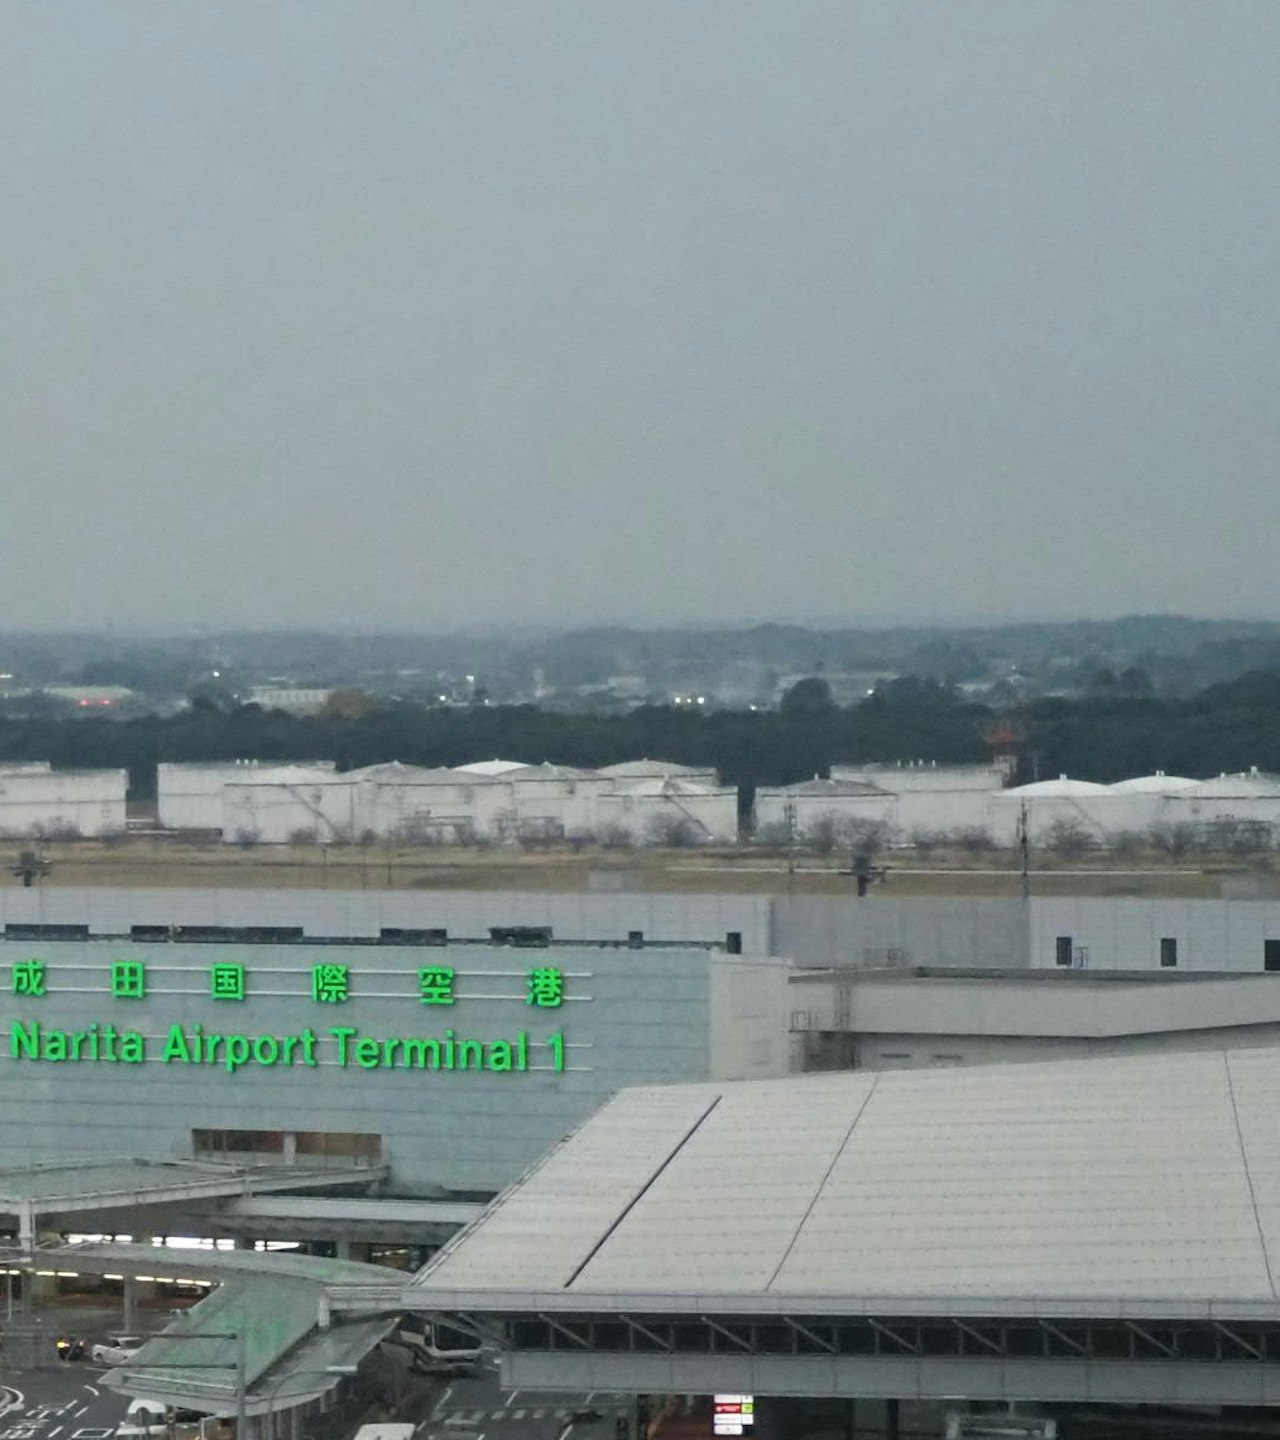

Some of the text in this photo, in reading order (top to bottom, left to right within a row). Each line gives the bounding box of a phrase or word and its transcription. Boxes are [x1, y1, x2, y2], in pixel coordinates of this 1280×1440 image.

[11, 959, 565, 1007] 成田国際空港
[9, 1020, 566, 1073] Narita Airport Terminal 1
